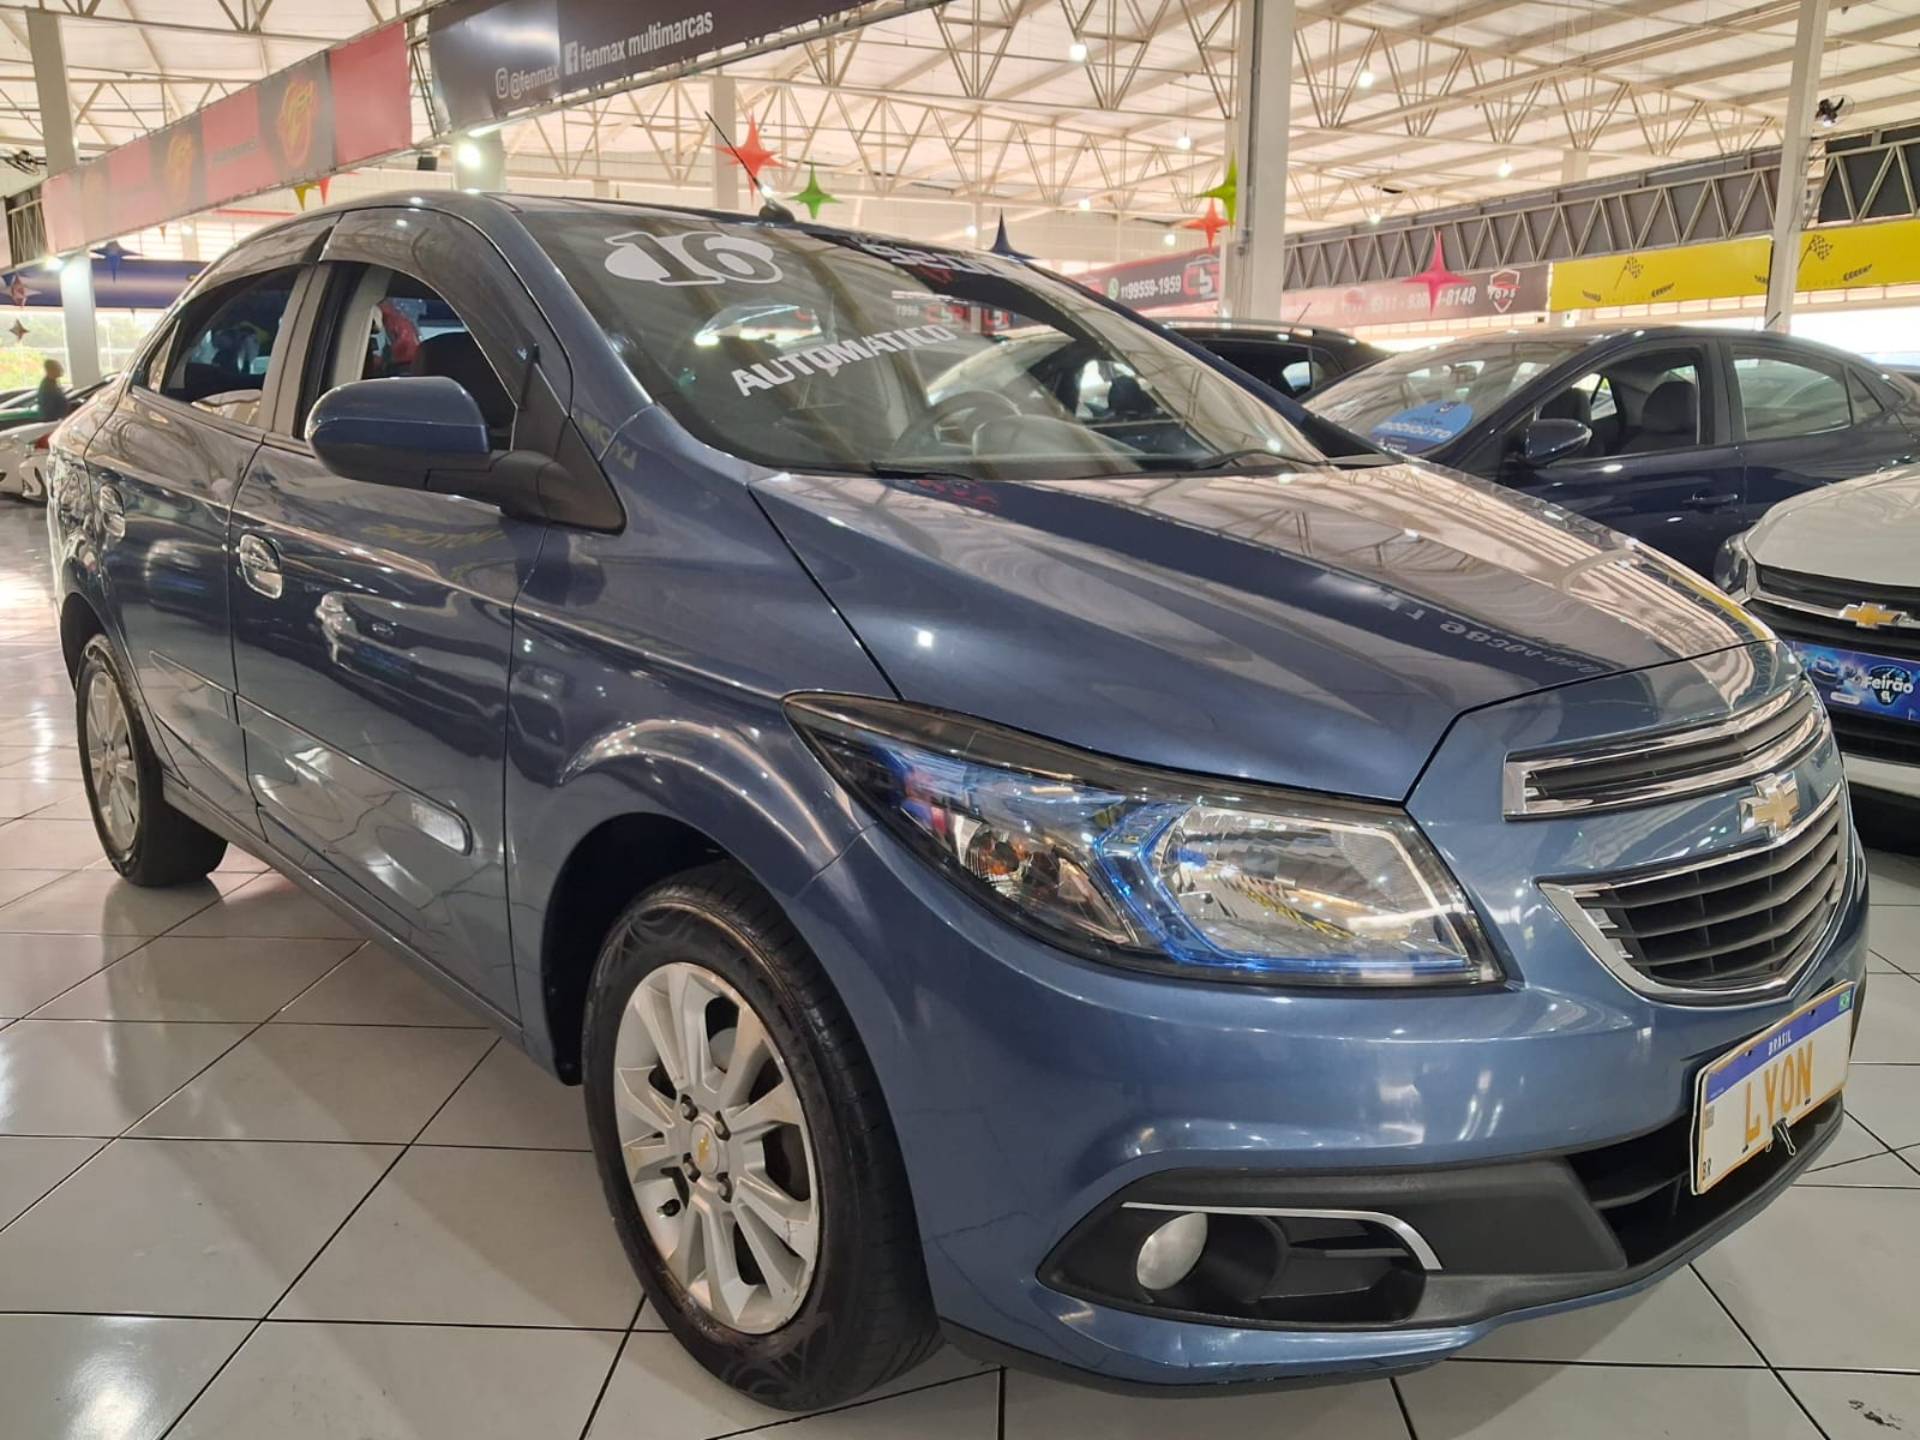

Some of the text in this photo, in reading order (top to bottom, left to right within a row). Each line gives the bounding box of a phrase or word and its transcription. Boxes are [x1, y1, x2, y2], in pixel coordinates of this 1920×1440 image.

[580, 40, 626, 72] fenmax
[628, 11, 714, 57] multimarcas
[605, 231, 783, 286] 16
[1768, 1030, 1793, 1056] BRASIL
[1744, 1040, 1814, 1146] LYON
